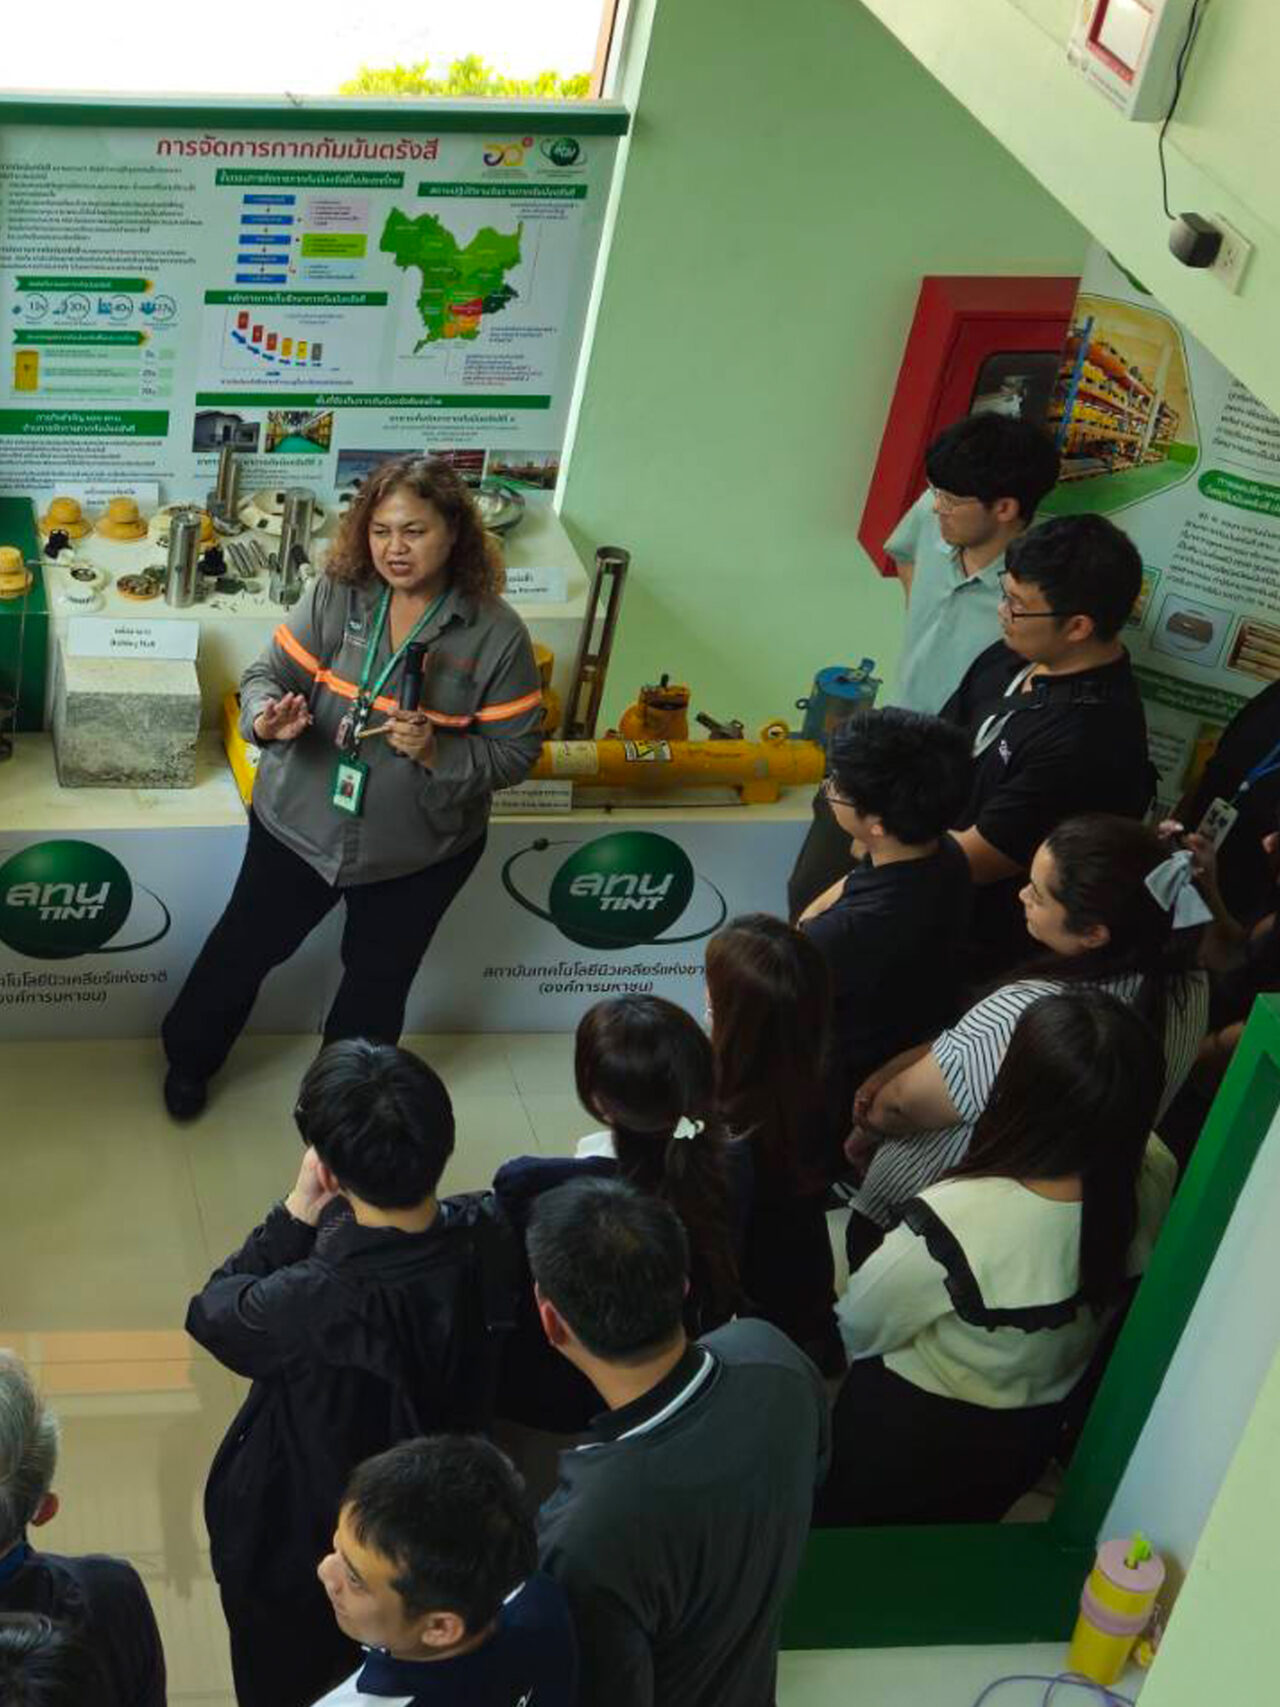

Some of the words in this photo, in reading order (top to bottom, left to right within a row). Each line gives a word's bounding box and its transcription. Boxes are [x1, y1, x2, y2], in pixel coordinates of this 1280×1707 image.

[156, 135, 439, 161] การจัดการกากกัมมันตรังสี
[600, 896, 663, 911] TINT
[38, 905, 104, 921] TINT
[483, 960, 705, 978] สถาบันเทคโนโลยีนิวเคลียร์แห่งชา
[539, 981, 654, 995] (องค์การมหาชน)
